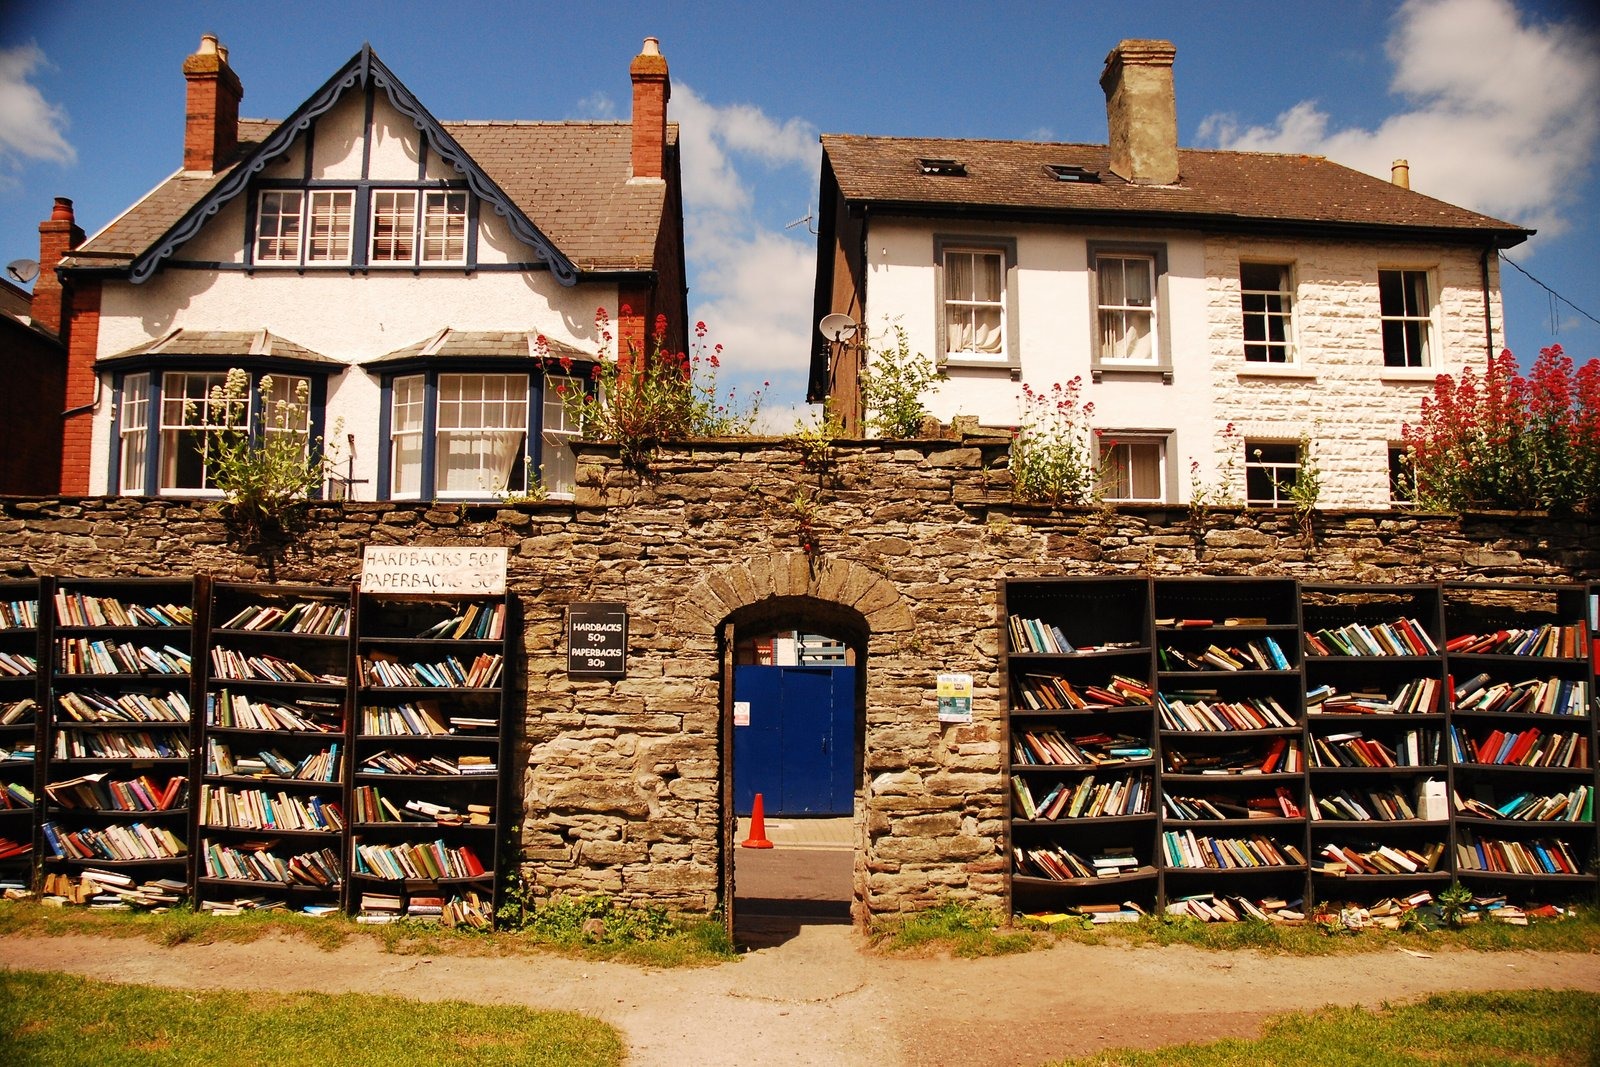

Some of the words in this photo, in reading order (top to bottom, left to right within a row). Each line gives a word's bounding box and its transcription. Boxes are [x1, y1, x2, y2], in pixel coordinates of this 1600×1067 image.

[367, 552, 462, 566] HARDBACKS
[573, 623, 622, 632] HARDBACKS
[587, 633, 606, 643] 50p
[571, 648, 622, 657] PAPERBACKS
[587, 658, 606, 668] 30p
